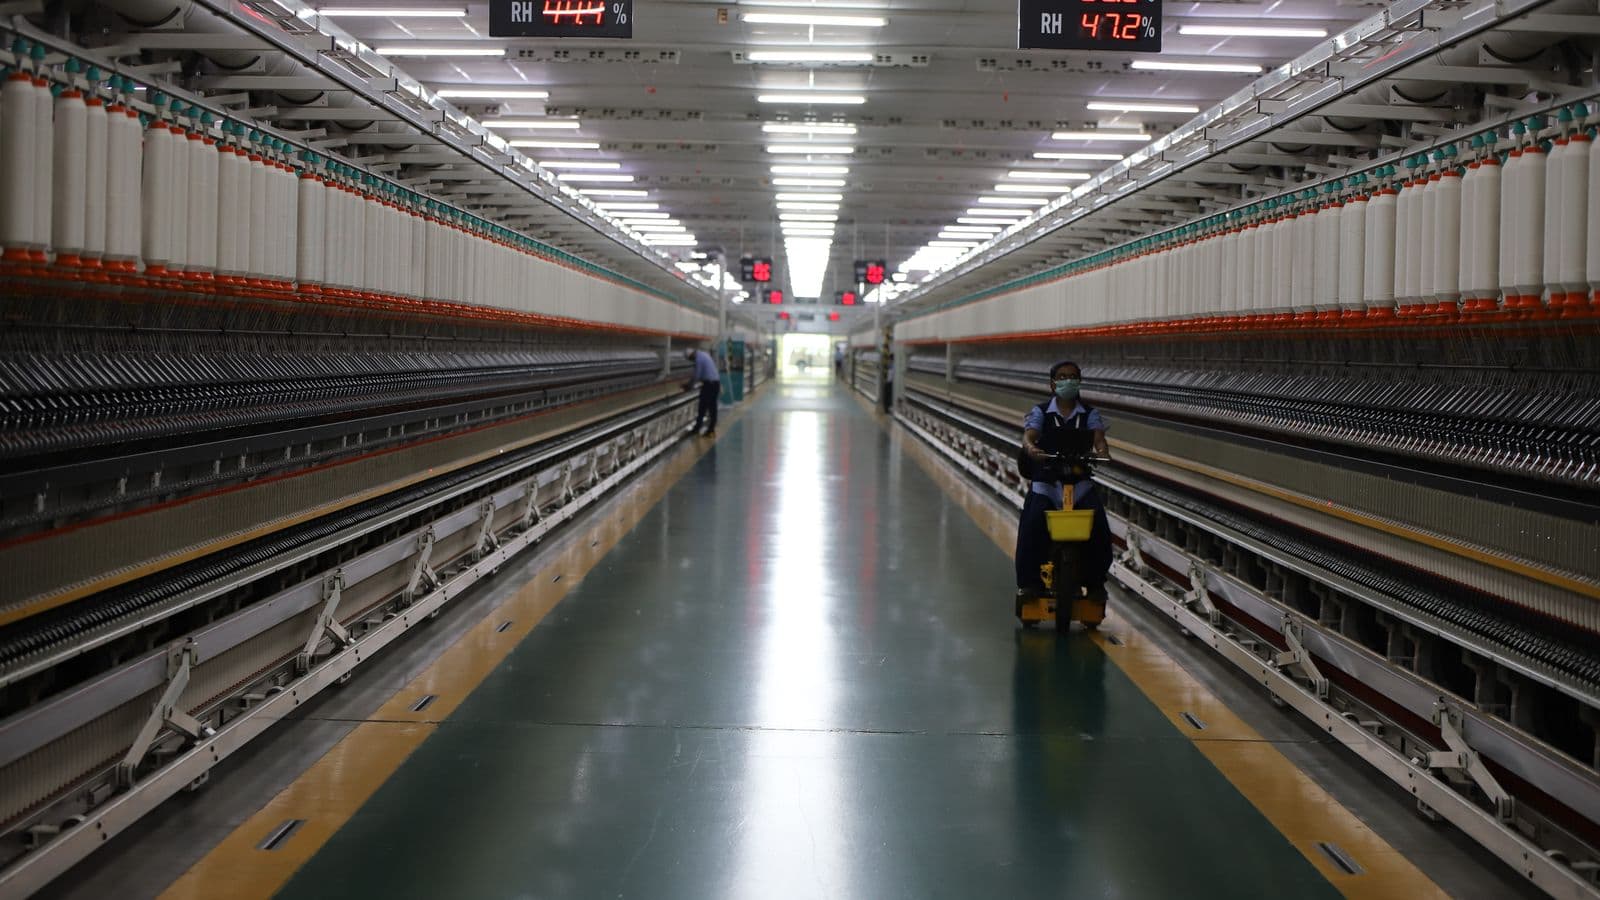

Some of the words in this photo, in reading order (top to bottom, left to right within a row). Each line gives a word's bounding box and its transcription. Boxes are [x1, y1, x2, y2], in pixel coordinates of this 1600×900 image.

[511, 1, 532, 22] RH
[613, 3, 627, 24] %
[1041, 13, 1062, 34] RH
